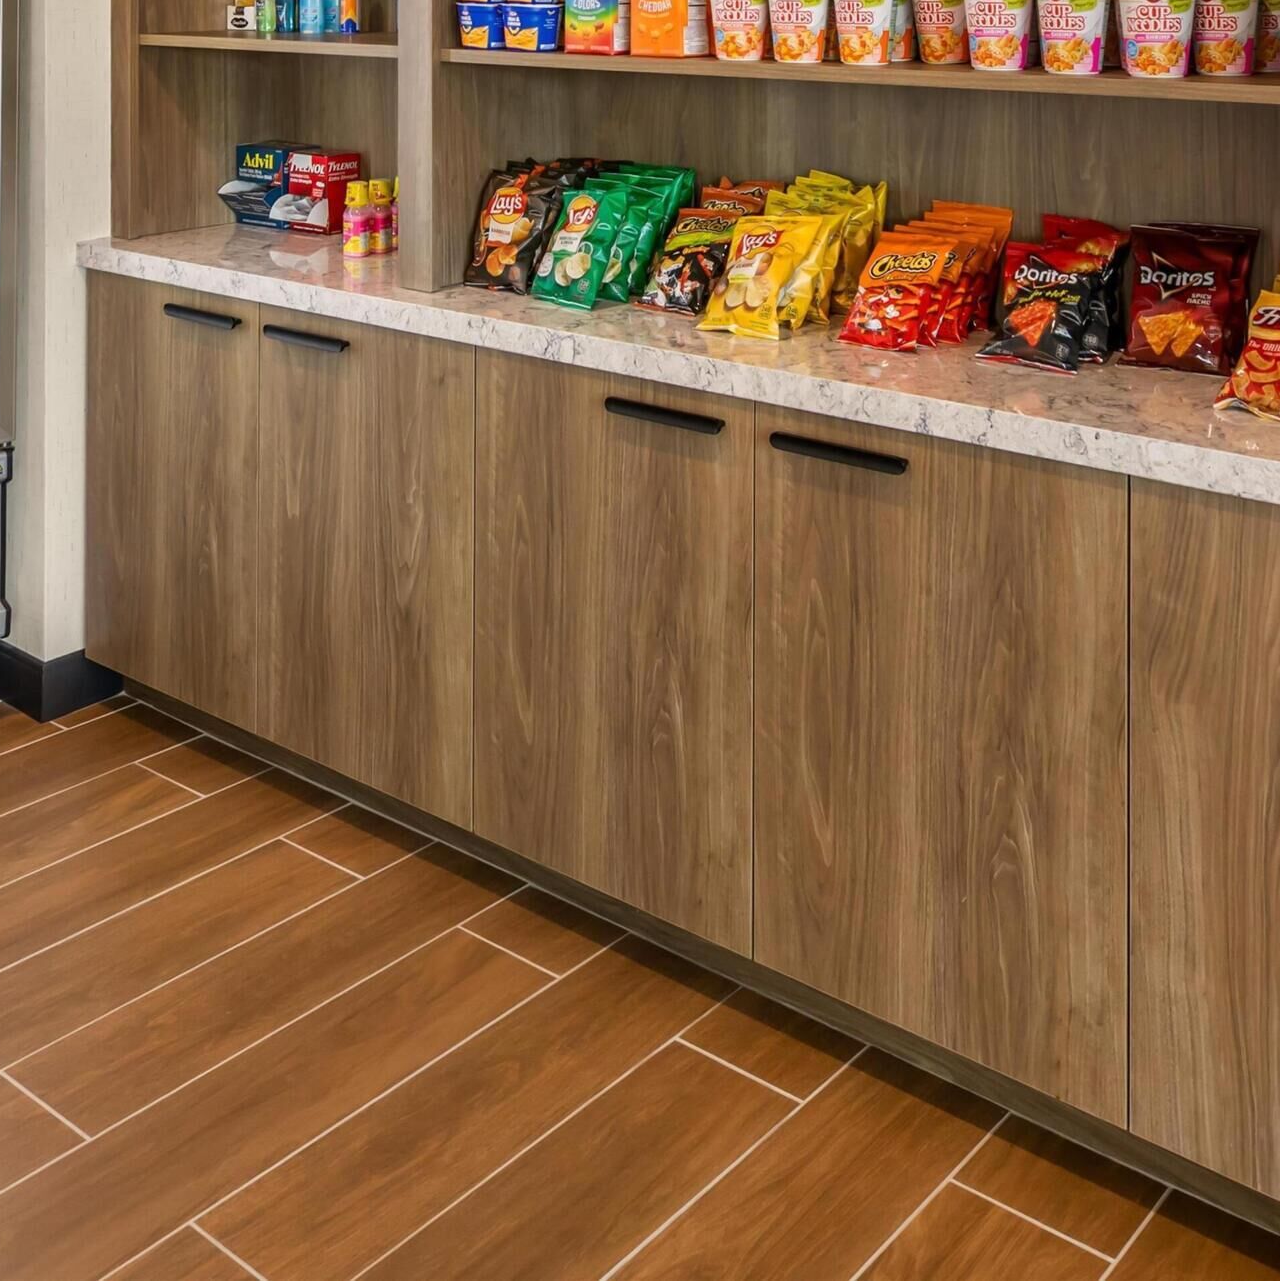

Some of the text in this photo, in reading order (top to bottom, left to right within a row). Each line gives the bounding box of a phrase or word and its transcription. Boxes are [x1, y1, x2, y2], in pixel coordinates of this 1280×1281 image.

[724, 0, 751, 11] CUP
[775, 0, 802, 12] CUP
[838, 0, 862, 12] CUP
[918, 1, 942, 13] CUP
[975, 2, 1006, 15] CUP
[1044, 4, 1072, 17] CUP
[1136, 5, 1171, 18] CUP
[1196, 6, 1224, 18] CUP
[1127, 18, 1181, 32] NOODLES
[243, 152, 274, 169] Advil
[328, 161, 358, 172] TYLENOL
[490, 194, 522, 214] Lay's
[675, 217, 731, 233] Cheetos
[742, 232, 777, 255] Lay's
[870, 253, 936, 278] Cheetos
[1015, 265, 1078, 284] Doritos
[1141, 266, 1215, 286] Doritos
